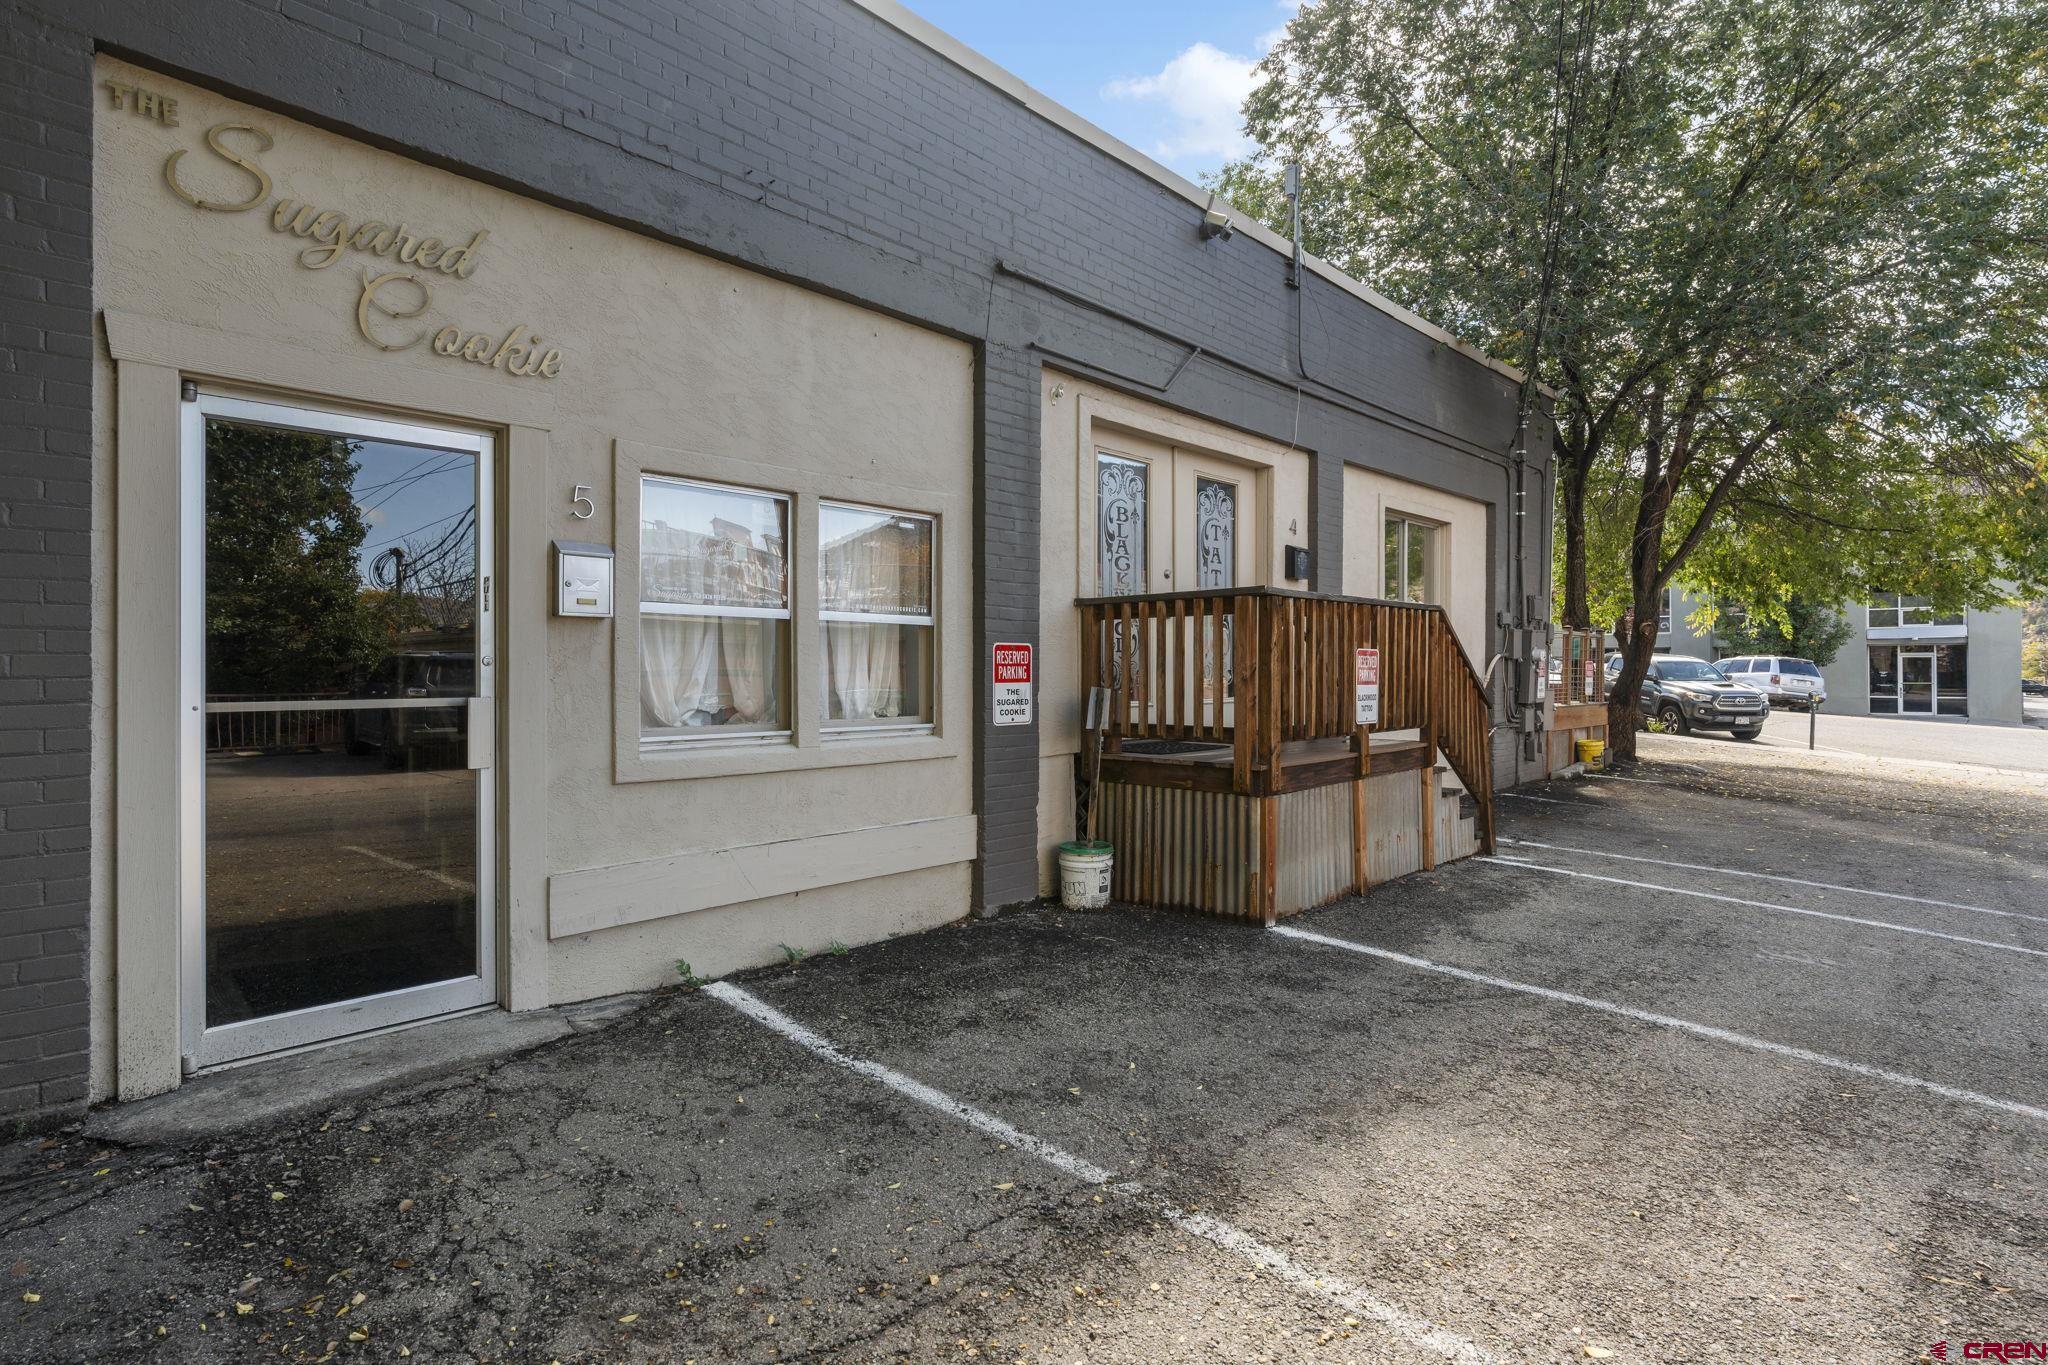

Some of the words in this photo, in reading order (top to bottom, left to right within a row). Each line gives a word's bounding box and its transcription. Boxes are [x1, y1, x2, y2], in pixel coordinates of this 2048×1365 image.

[104, 80, 180, 128] THE
[165, 121, 491, 280] Sugared
[357, 268, 565, 380] Cookie
[572, 485, 595, 519] 5
[1288, 518, 1297, 536] 4
[996, 650, 1029, 665] RESERVED
[998, 666, 1027, 679] PARKING
[1006, 688, 1020, 696] THE
[996, 698, 1029, 706] SUGARED
